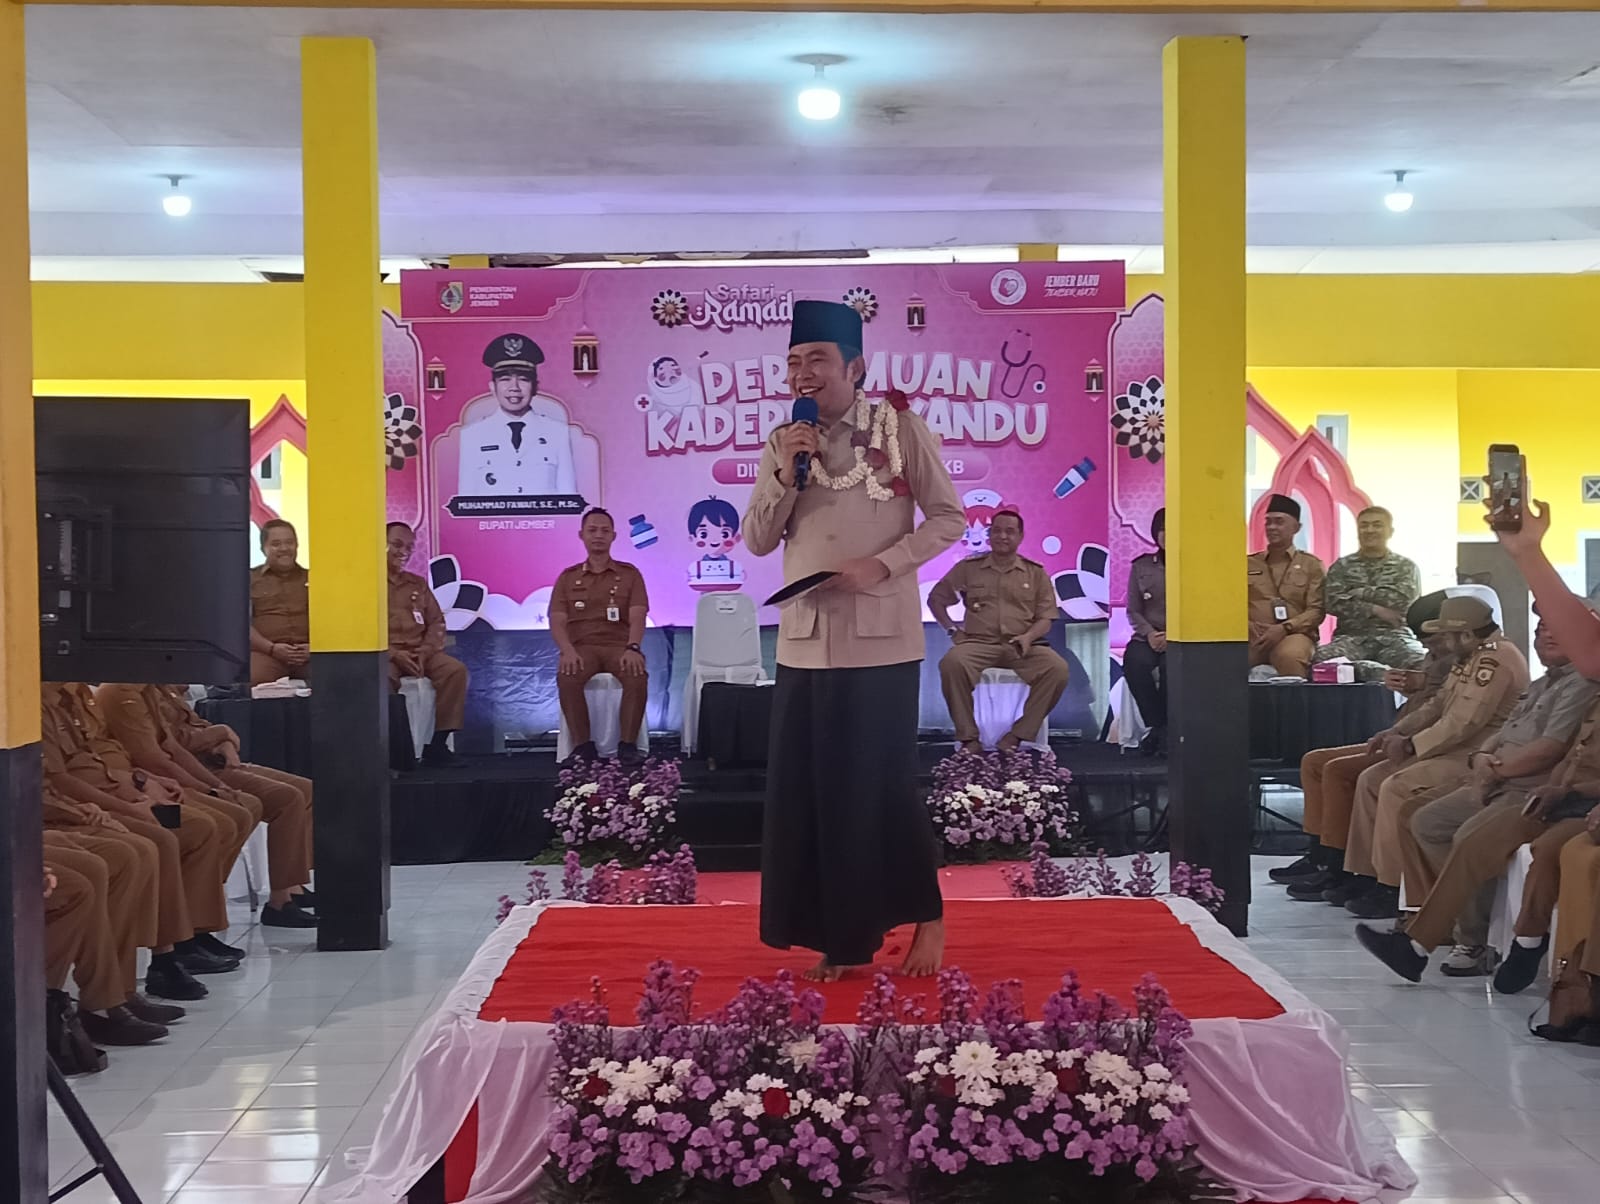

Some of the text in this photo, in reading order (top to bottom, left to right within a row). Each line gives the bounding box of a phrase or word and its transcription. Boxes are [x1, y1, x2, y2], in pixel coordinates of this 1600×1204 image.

[717, 283, 775, 299] Safari
[688, 288, 794, 329] Ramad
[458, 501, 506, 510] MUHAMMAD
[479, 519, 555, 530] BUPATI JEMBER
